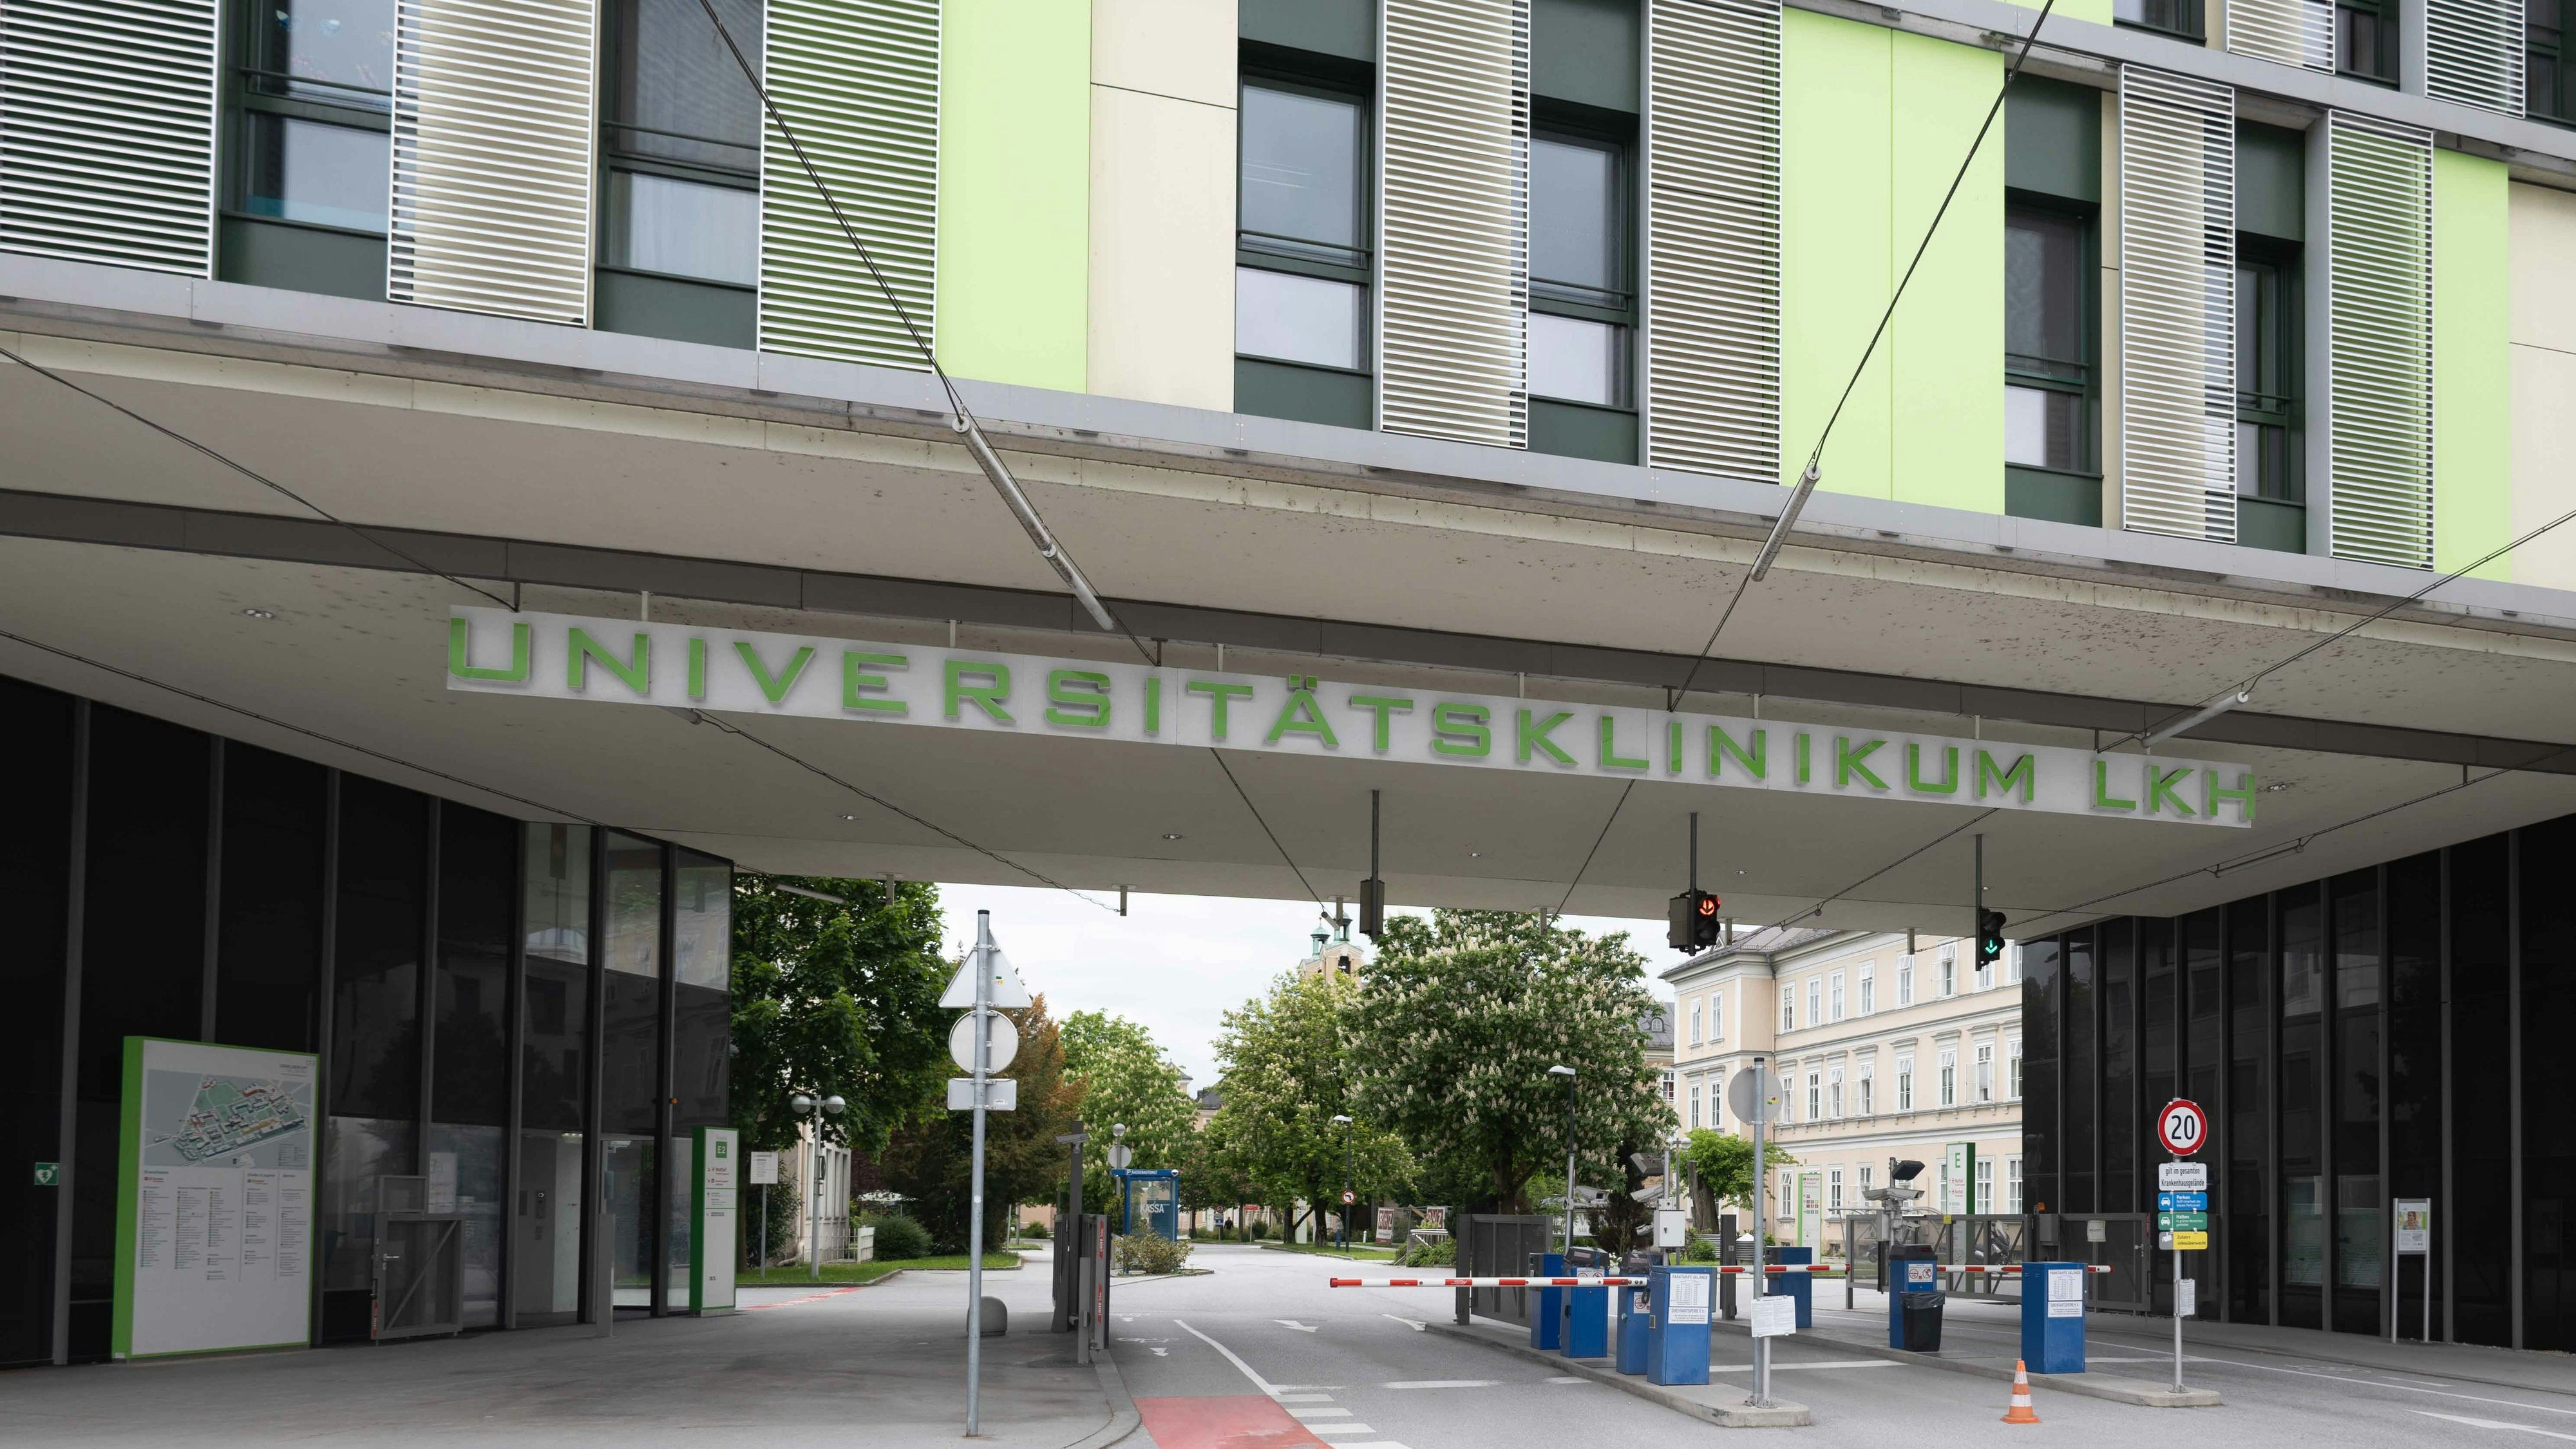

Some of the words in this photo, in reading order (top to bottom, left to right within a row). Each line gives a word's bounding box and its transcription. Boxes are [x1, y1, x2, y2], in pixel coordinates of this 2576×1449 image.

[448, 616, 2035, 803] UNIVERSITÄTSKLINIKUM
[2095, 760, 2257, 821] LKH
[2172, 1115, 2195, 1140] 20
[1955, 1152, 1961, 1168] E
[2161, 1179, 2204, 1188] Krankenhausgelände
[1140, 1204, 1164, 1213] KASSA
